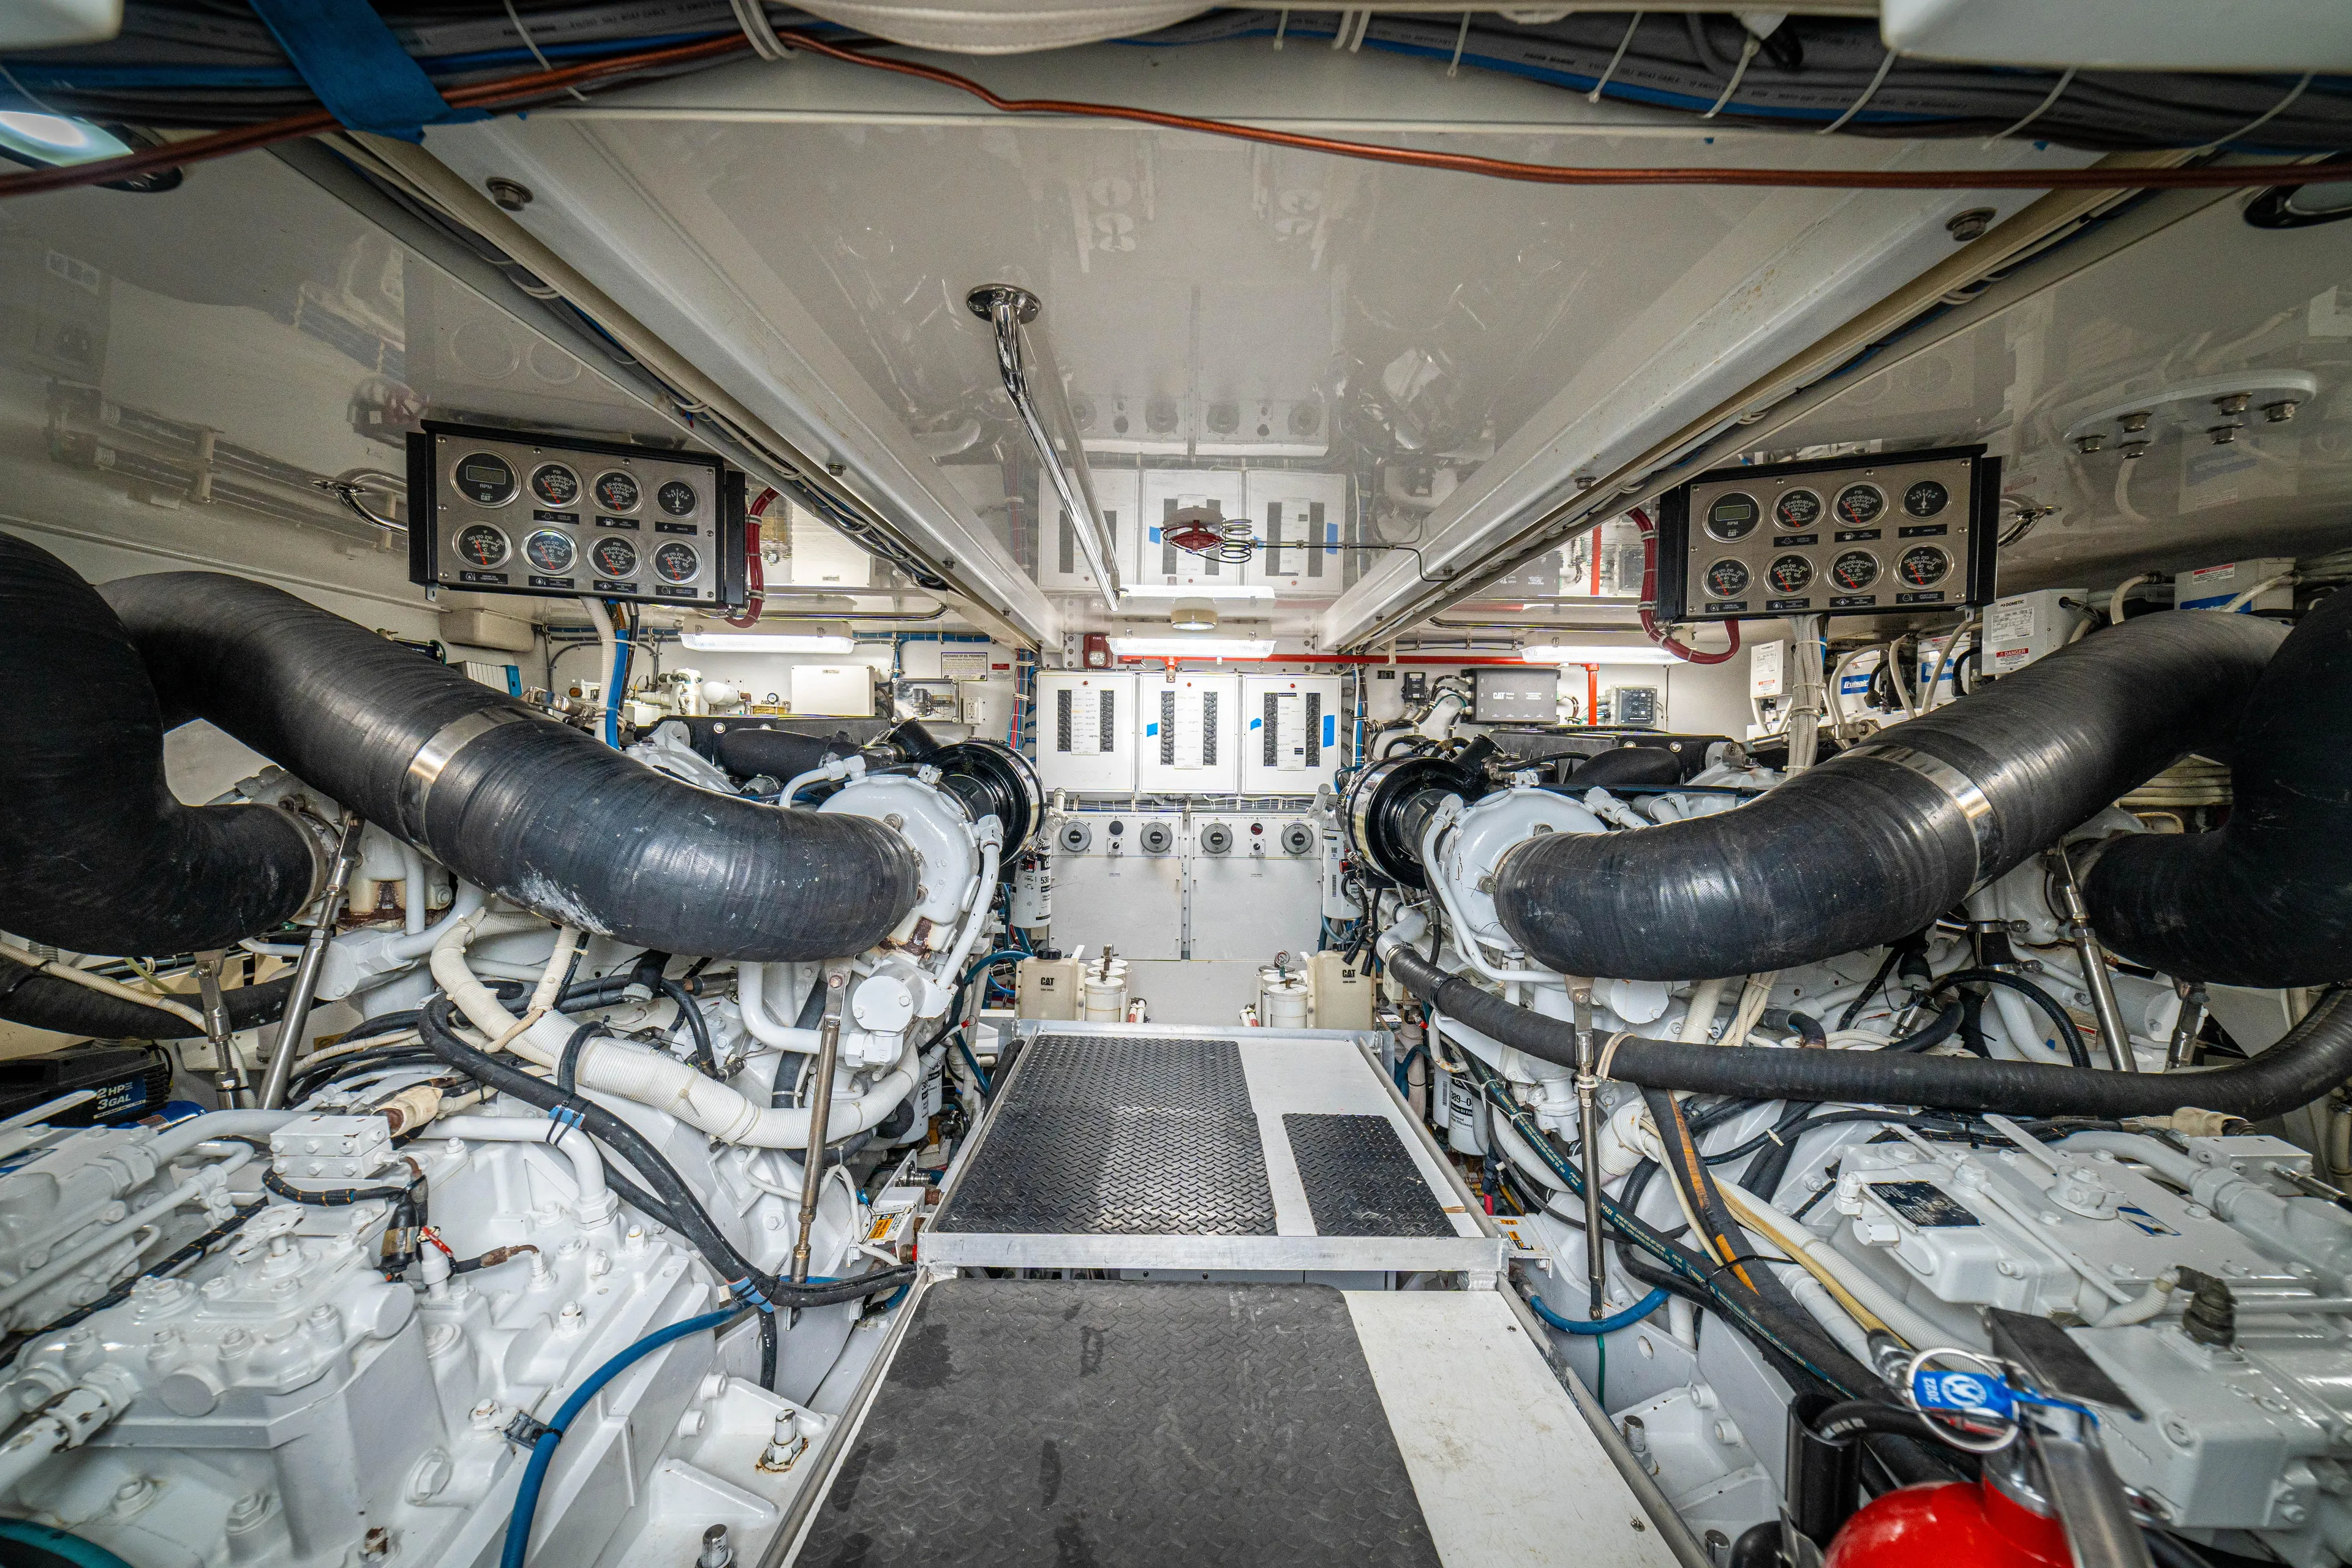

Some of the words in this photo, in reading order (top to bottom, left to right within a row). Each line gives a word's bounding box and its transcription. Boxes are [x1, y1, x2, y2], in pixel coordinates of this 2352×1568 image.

[1342, 969, 1355, 978] CAT
[96, 1088, 107, 1099] 2
[108, 1085, 125, 1096] HP
[97, 1099, 108, 1110] 3
[108, 1094, 131, 1107] GAL
[1501, 1093, 1517, 1114] TRIDENT-FLEX
[1452, 1112, 1464, 1121] Advanced
[1597, 1201, 1614, 1216] T-FLEX
[1922, 1377, 1941, 1403] 2022
